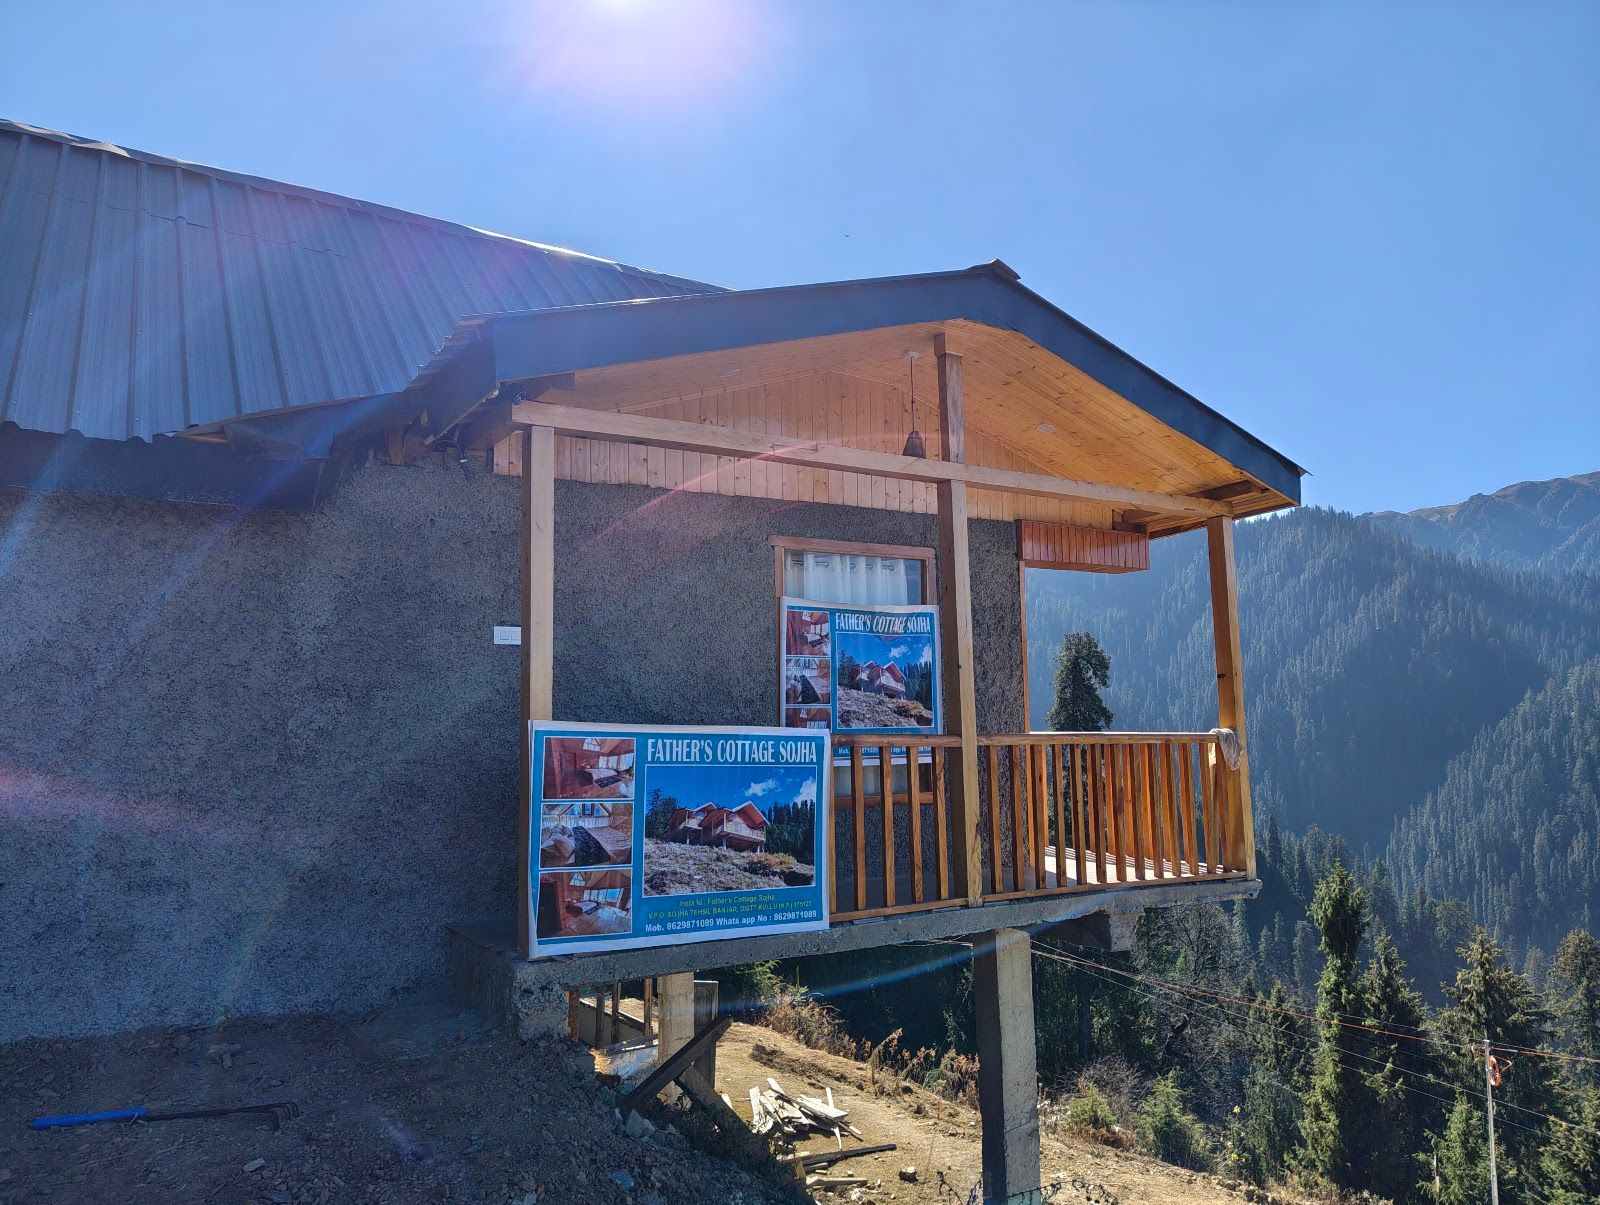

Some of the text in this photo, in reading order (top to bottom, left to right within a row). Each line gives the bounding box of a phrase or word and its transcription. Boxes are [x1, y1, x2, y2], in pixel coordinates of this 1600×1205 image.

[872, 616, 907, 633] COTTAGE
[907, 616, 931, 633] SOJHA
[717, 739, 776, 763] COTTAGE
[779, 740, 817, 763] SOJHA
[758, 894, 775, 902] Sojha
[667, 910, 688, 918] SOJHA
[690, 908, 711, 916] TEHSIL
[758, 903, 778, 911] KULLU
[645, 923, 664, 933] Mob.
[666, 918, 714, 930] 8629871089
[716, 917, 740, 926] Whats
[741, 917, 755, 925] app
[773, 910, 817, 921] 8629871089
